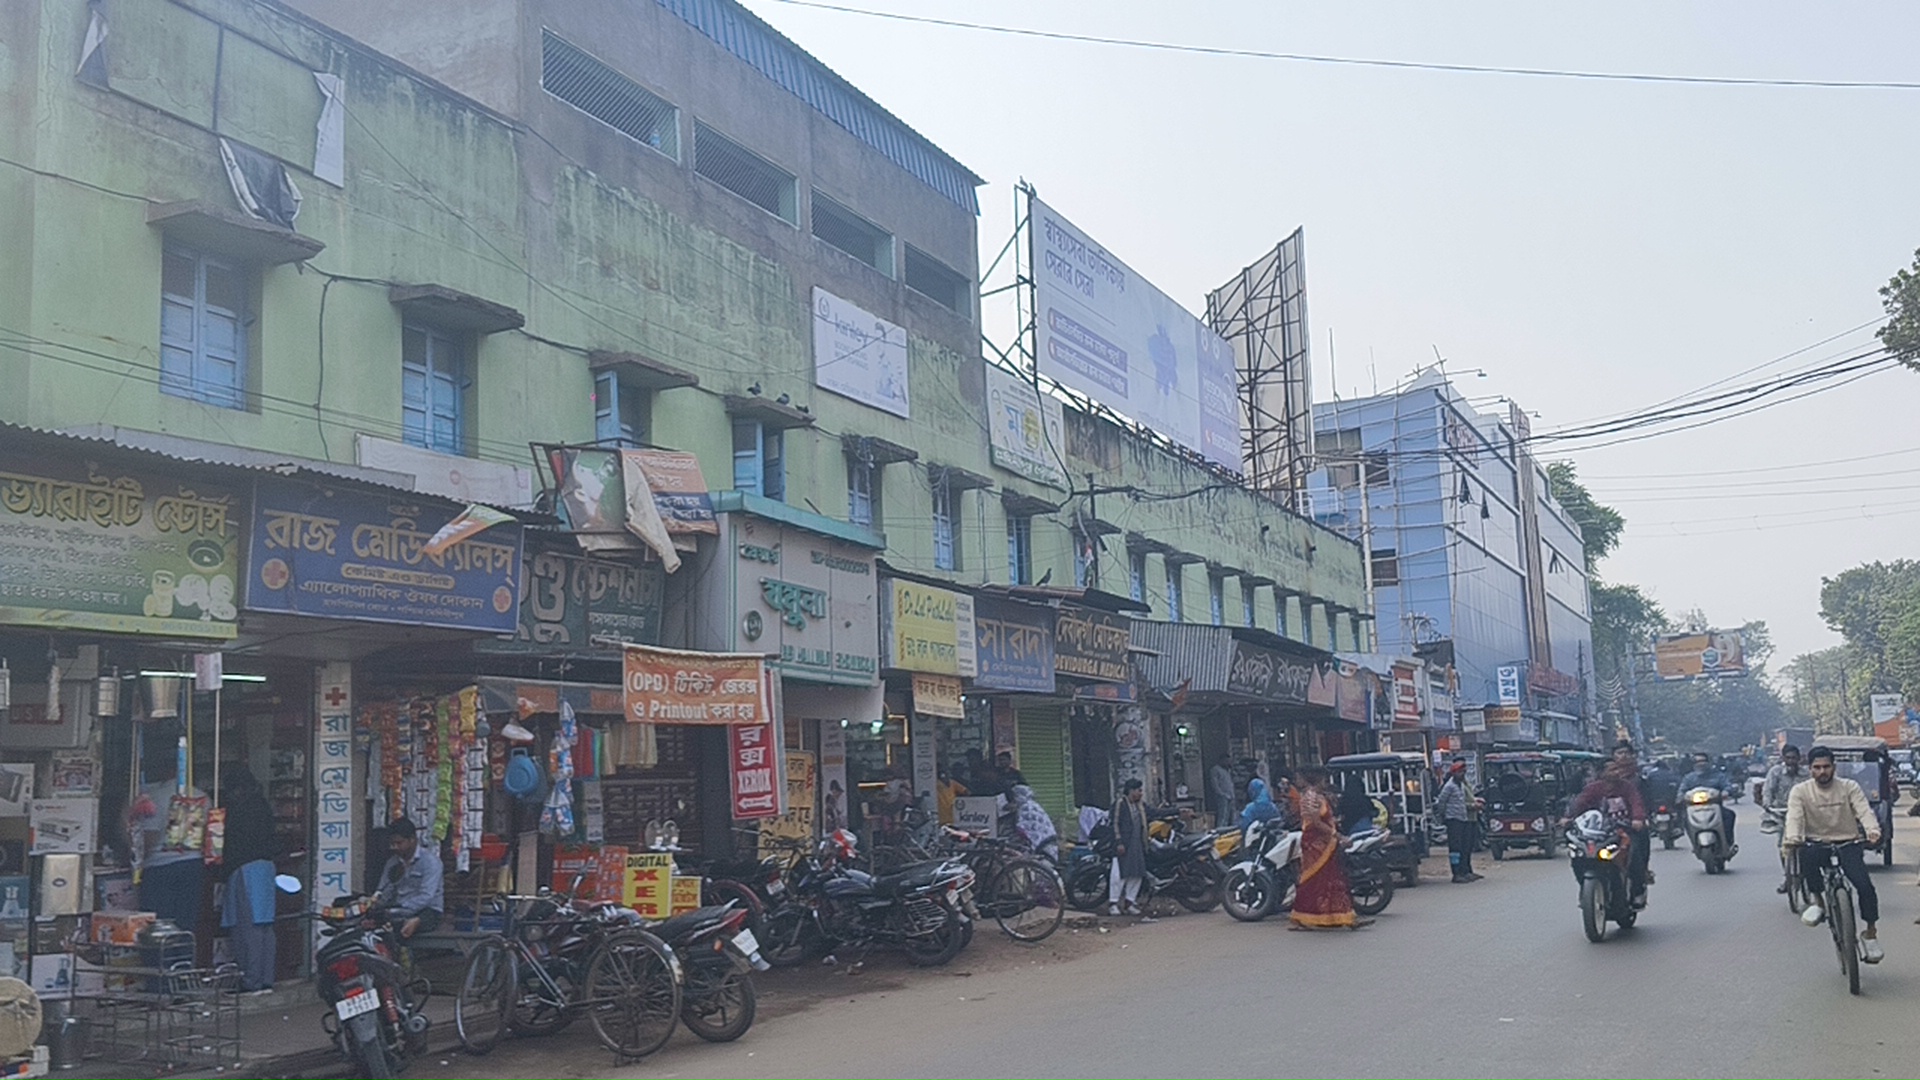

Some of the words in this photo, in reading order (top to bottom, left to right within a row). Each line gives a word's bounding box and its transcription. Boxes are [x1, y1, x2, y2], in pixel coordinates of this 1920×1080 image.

[2, 468, 145, 528] ভ্যারাইটি
[263, 509, 340, 556] রাজ
[976, 613, 1050, 664] সারদা
[720, 679, 759, 695] জেরক্স
[632, 702, 645, 718] ও
[648, 700, 709, 719] Printout
[709, 703, 736, 719] করা
[737, 703, 755, 720] হয়
[322, 713, 350, 758] রাজ
[737, 768, 771, 794] XEROX
[320, 765, 350, 893] মেডিক্যালস্
[959, 811, 990, 824] kinley
[627, 855, 669, 868] DIGITAL
